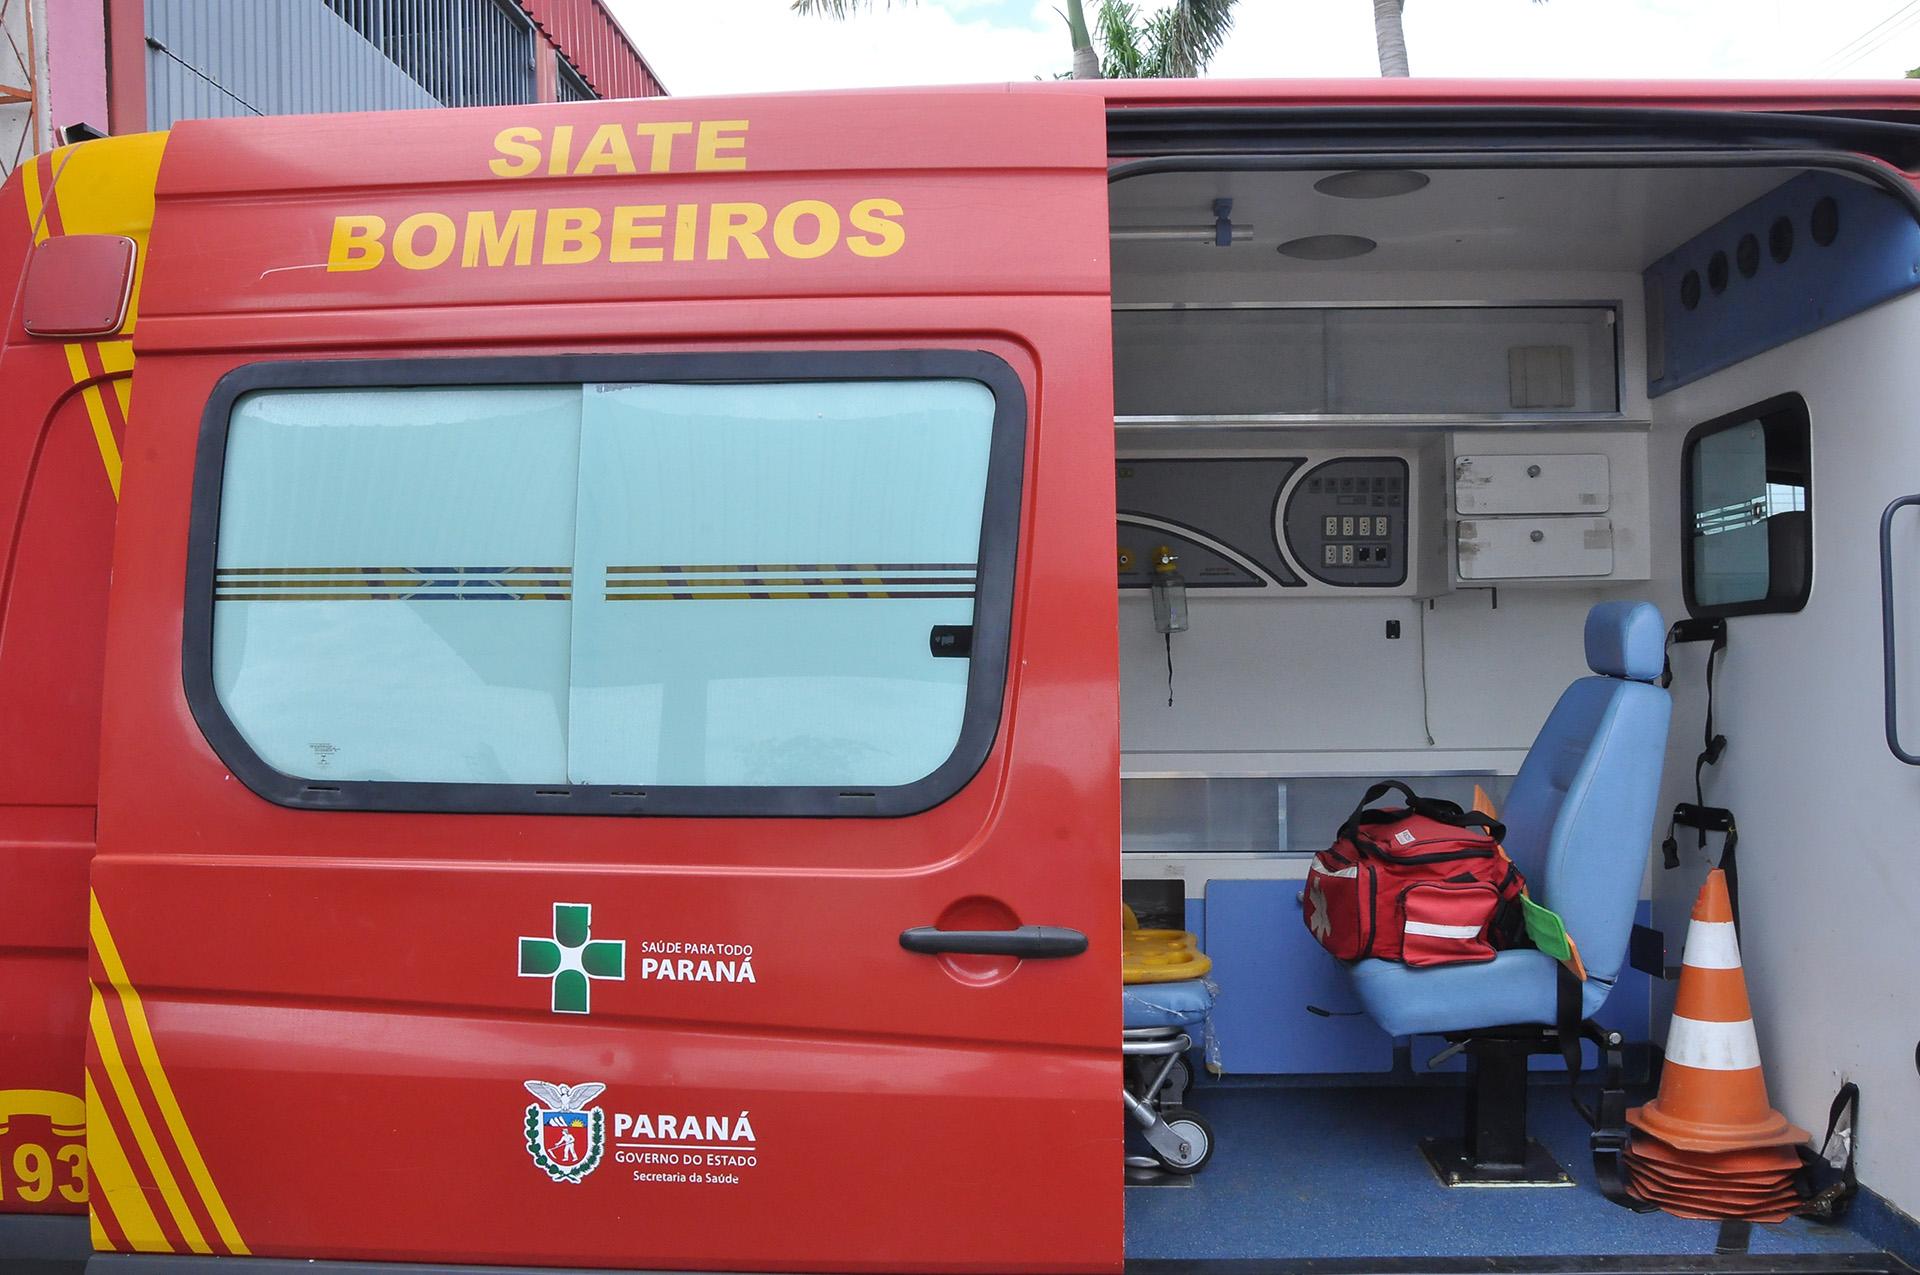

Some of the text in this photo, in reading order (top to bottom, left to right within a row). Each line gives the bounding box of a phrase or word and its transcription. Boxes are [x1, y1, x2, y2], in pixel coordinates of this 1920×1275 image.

[488, 120, 750, 178] SIATE
[326, 198, 906, 273] BOMBEIROS
[641, 940, 753, 956] SAÚDE PARA TODO
[641, 956, 757, 984] PARANÁ
[614, 1110, 757, 1142] PARANÁ
[0, 1143, 90, 1203] 93
[615, 1151, 758, 1168] GOVERNO DO ESTADO
[633, 1170, 739, 1185] Secretaria da Saúde
